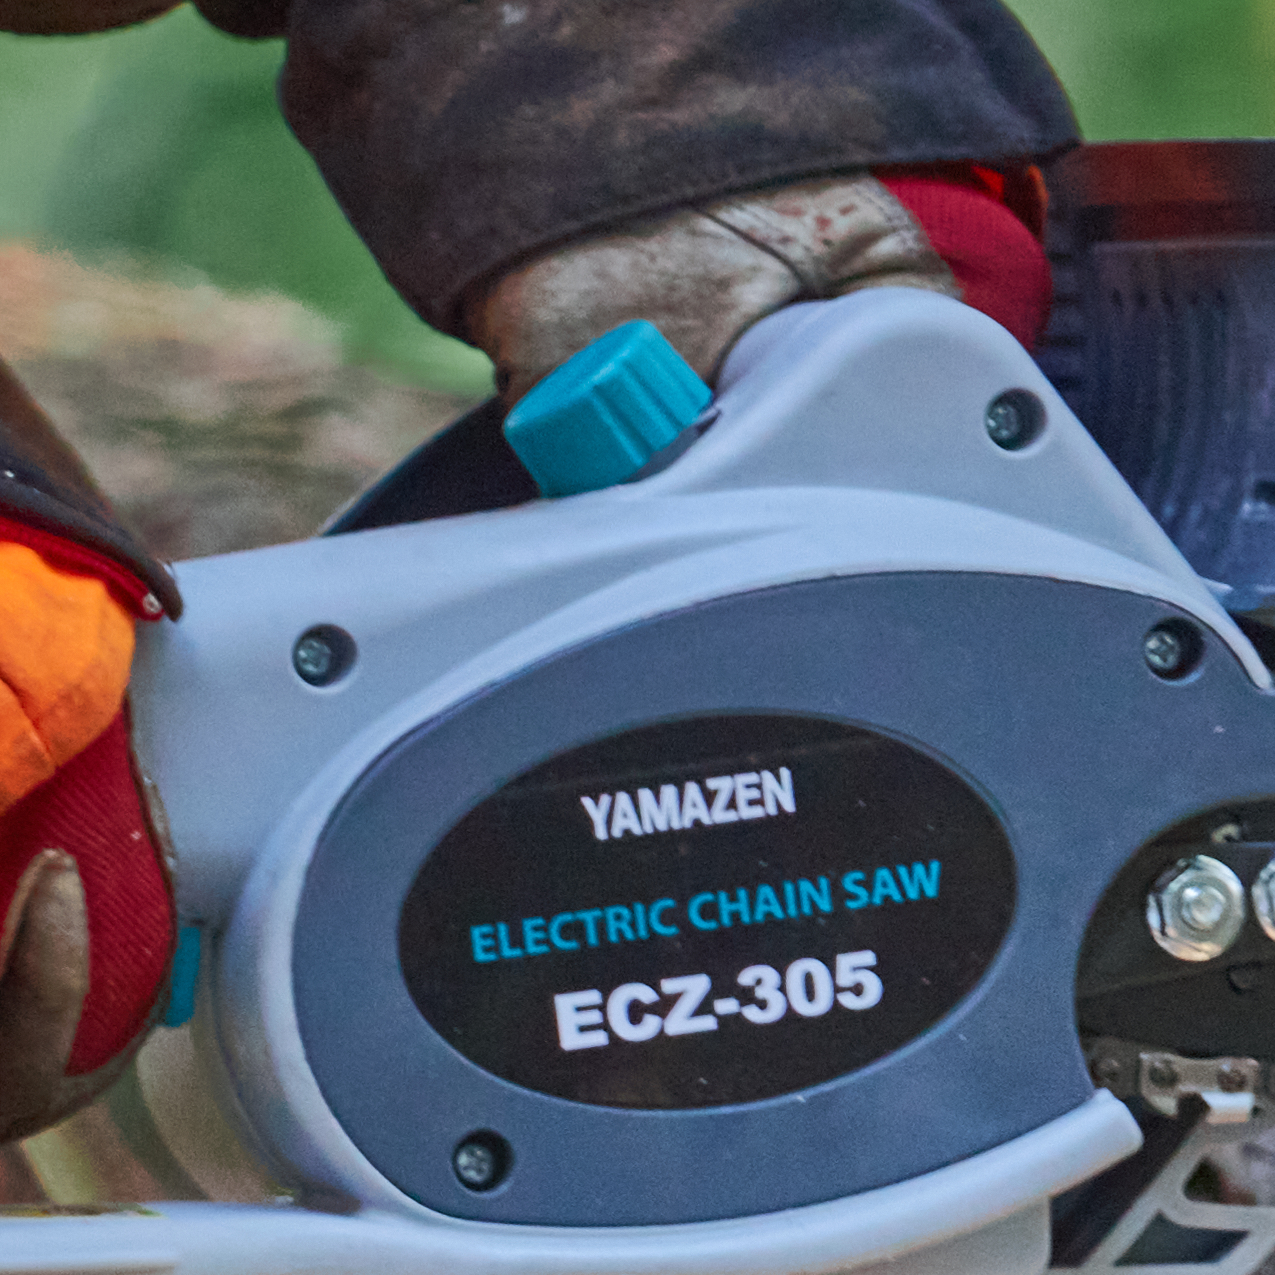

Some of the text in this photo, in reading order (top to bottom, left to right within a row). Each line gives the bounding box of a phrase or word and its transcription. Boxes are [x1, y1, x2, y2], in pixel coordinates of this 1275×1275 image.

[580, 766, 797, 842] YAMAZEN
[470, 859, 942, 964] ELECTRIC CHAIN SAW
[553, 949, 884, 1052] ECZ-305
